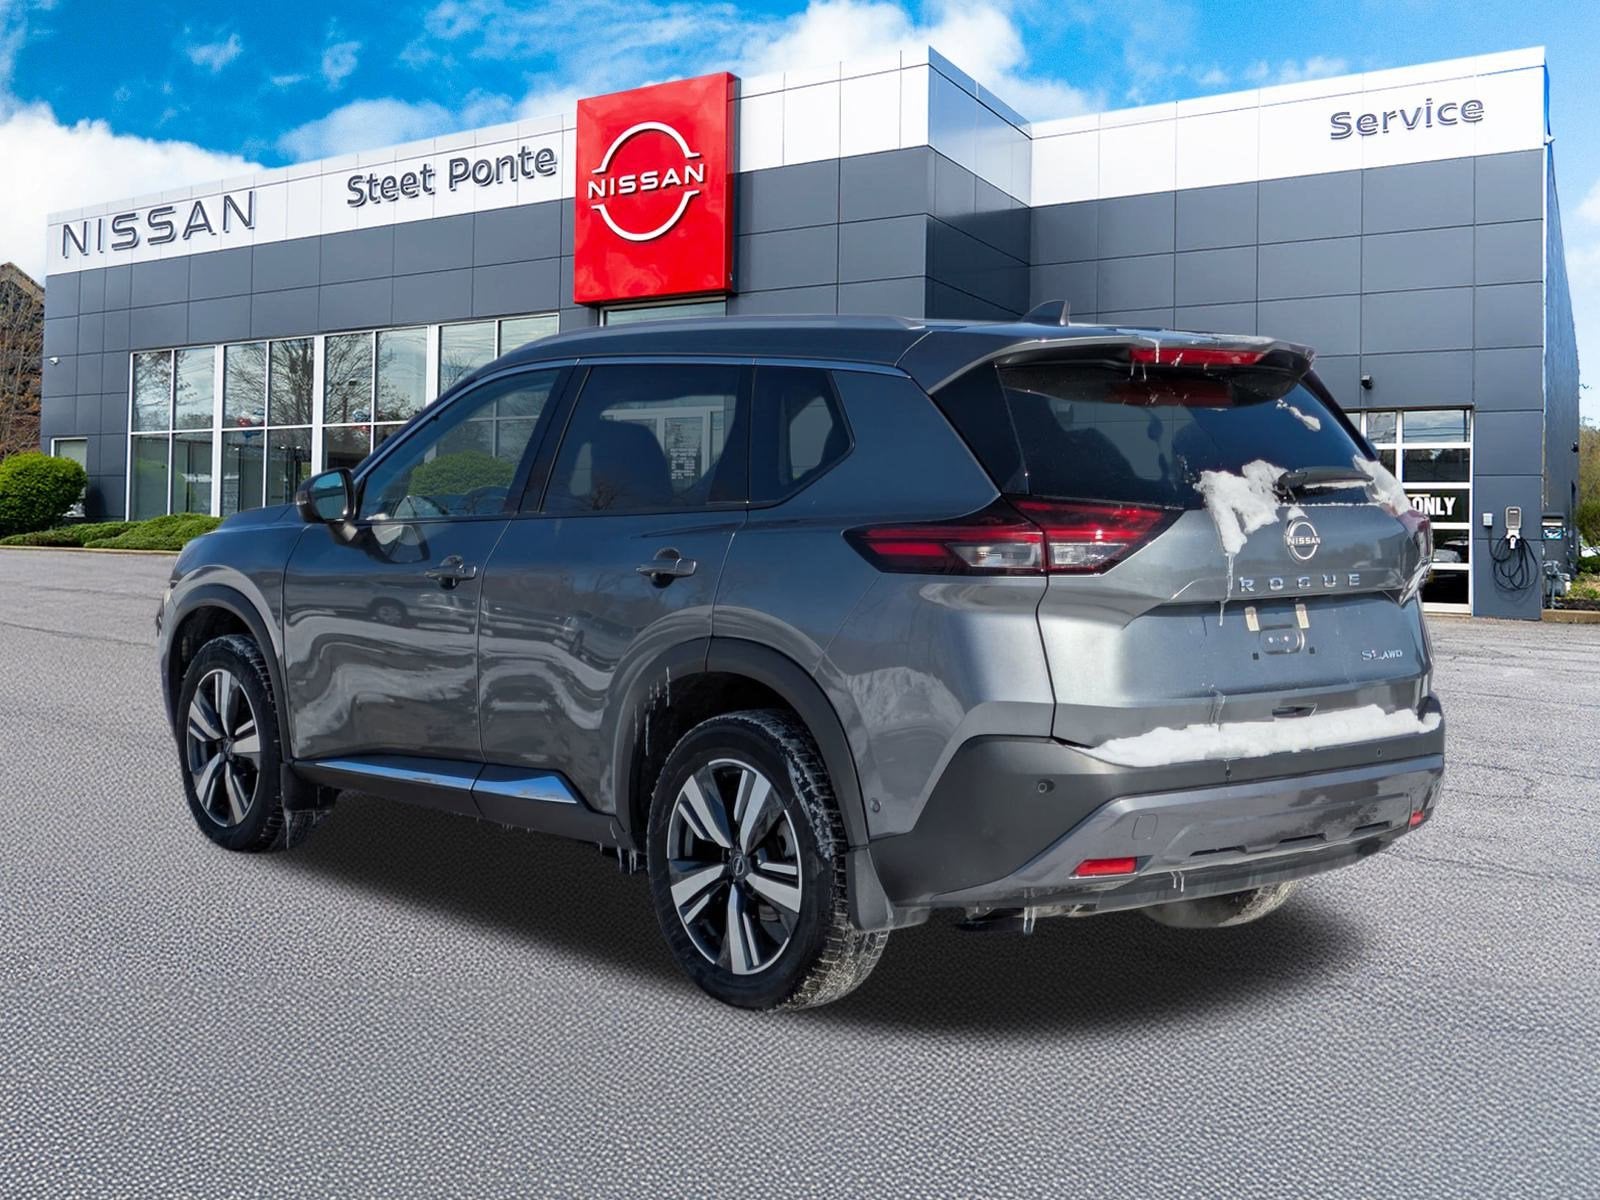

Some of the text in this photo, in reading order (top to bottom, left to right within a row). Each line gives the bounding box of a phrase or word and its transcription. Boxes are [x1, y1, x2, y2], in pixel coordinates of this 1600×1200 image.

[1330, 98, 1484, 140] Service
[347, 146, 558, 208] Steet Ponte
[587, 163, 704, 199] NISSAN
[62, 190, 257, 259] NISSAN
[1412, 496, 1457, 516] ONLY
[1287, 536, 1321, 545] NISSAN
[1239, 573, 1361, 593] ROGUE
[1381, 649, 1403, 660] AWD
